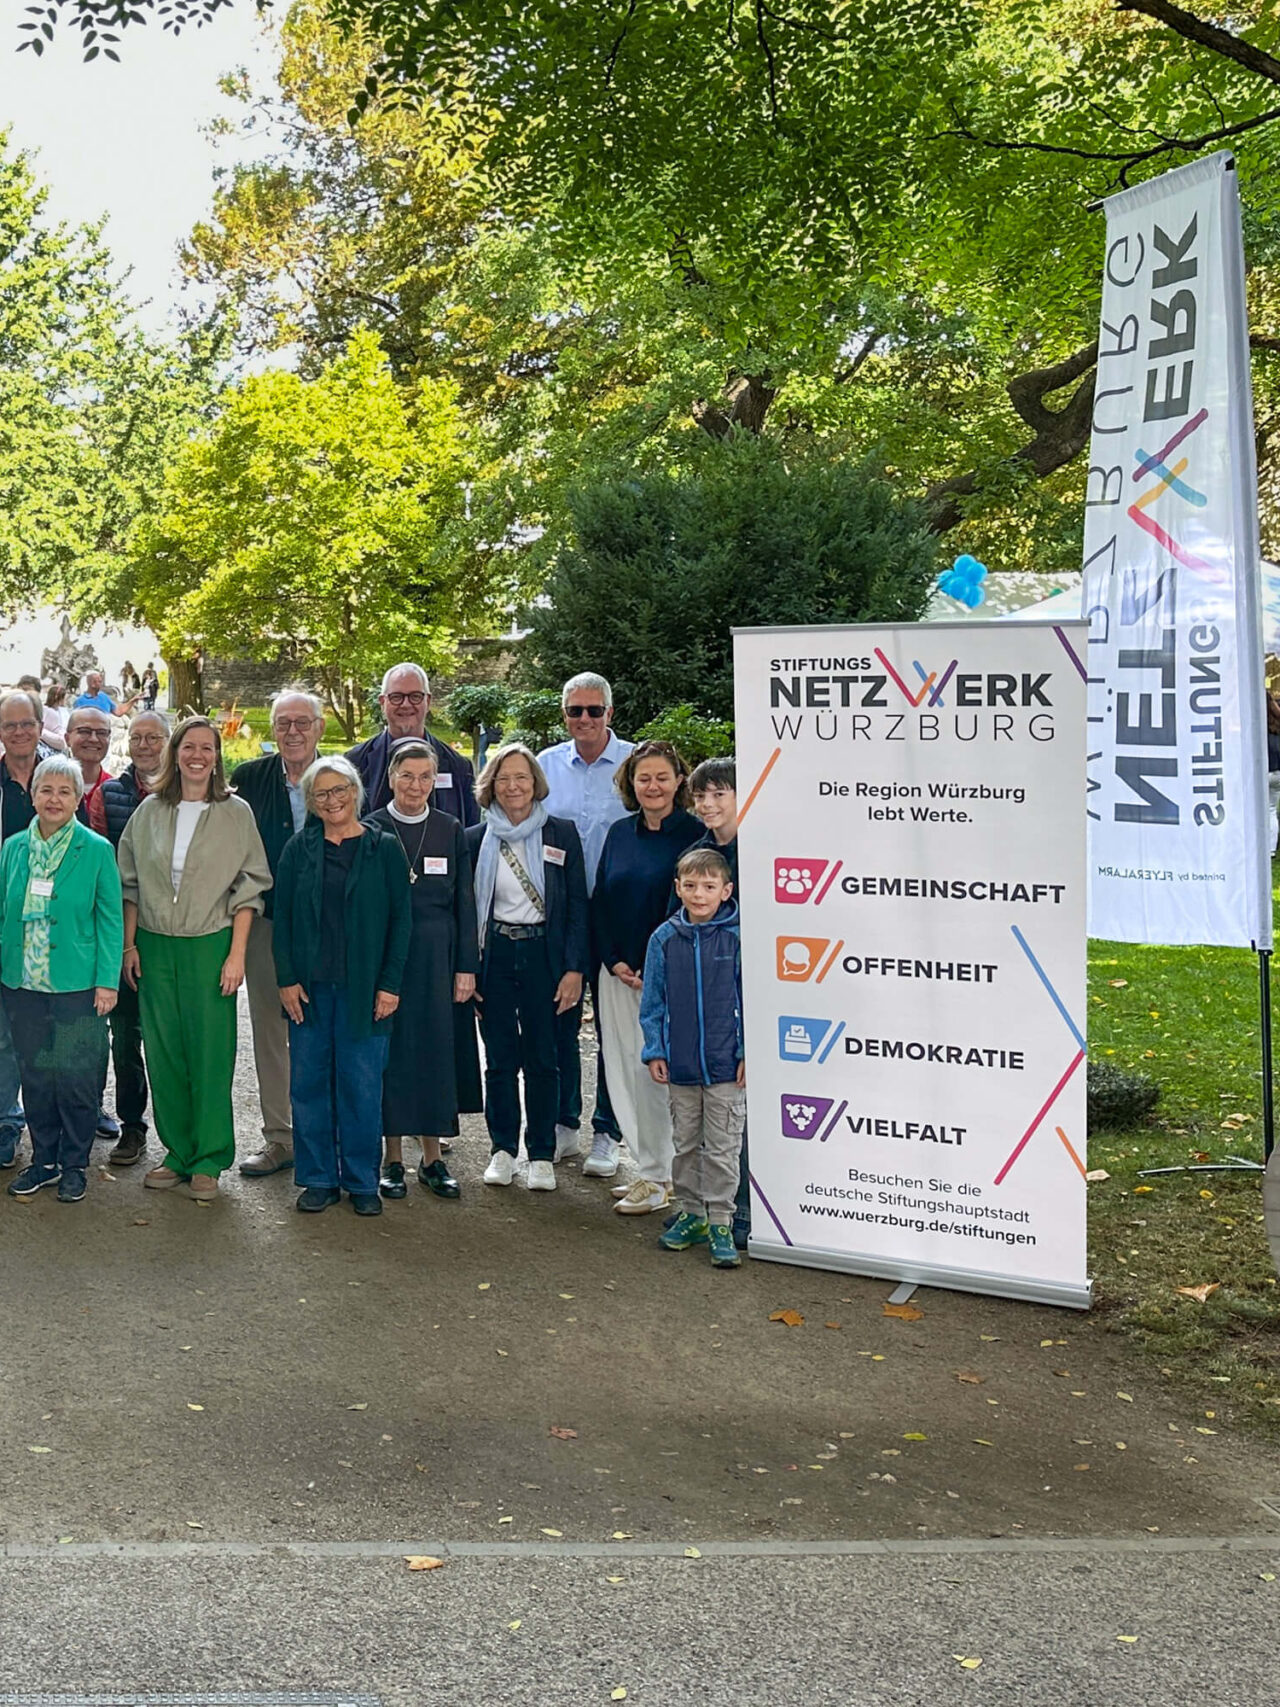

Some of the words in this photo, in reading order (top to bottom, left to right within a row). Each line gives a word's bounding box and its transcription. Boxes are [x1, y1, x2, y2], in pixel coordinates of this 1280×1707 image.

[770, 657, 872, 672] STIFTUNGS
[770, 647, 1053, 708] NETZWERK
[770, 709, 1056, 742] WÜRZBURG
[818, 781, 850, 798] Die
[855, 782, 922, 800] Region
[927, 783, 1026, 803] Würzburg
[867, 806, 905, 822] lebt
[909, 807, 974, 823] Werte.
[841, 876, 1066, 904] GEMEINSCHAFT
[842, 956, 998, 983] OFFENHEIT
[844, 1037, 1025, 1070] DEMOKRATIE
[846, 1115, 967, 1146] VIELFALT
[848, 1168, 924, 1191] Besuchen
[927, 1178, 953, 1194] Sie
[956, 1181, 982, 1198] die
[804, 1182, 874, 1203] deutsche
[877, 1190, 1030, 1224] Stiftungshauptstadt
[799, 1203, 1037, 1246] www.wuerzburg.de/stiftungen
